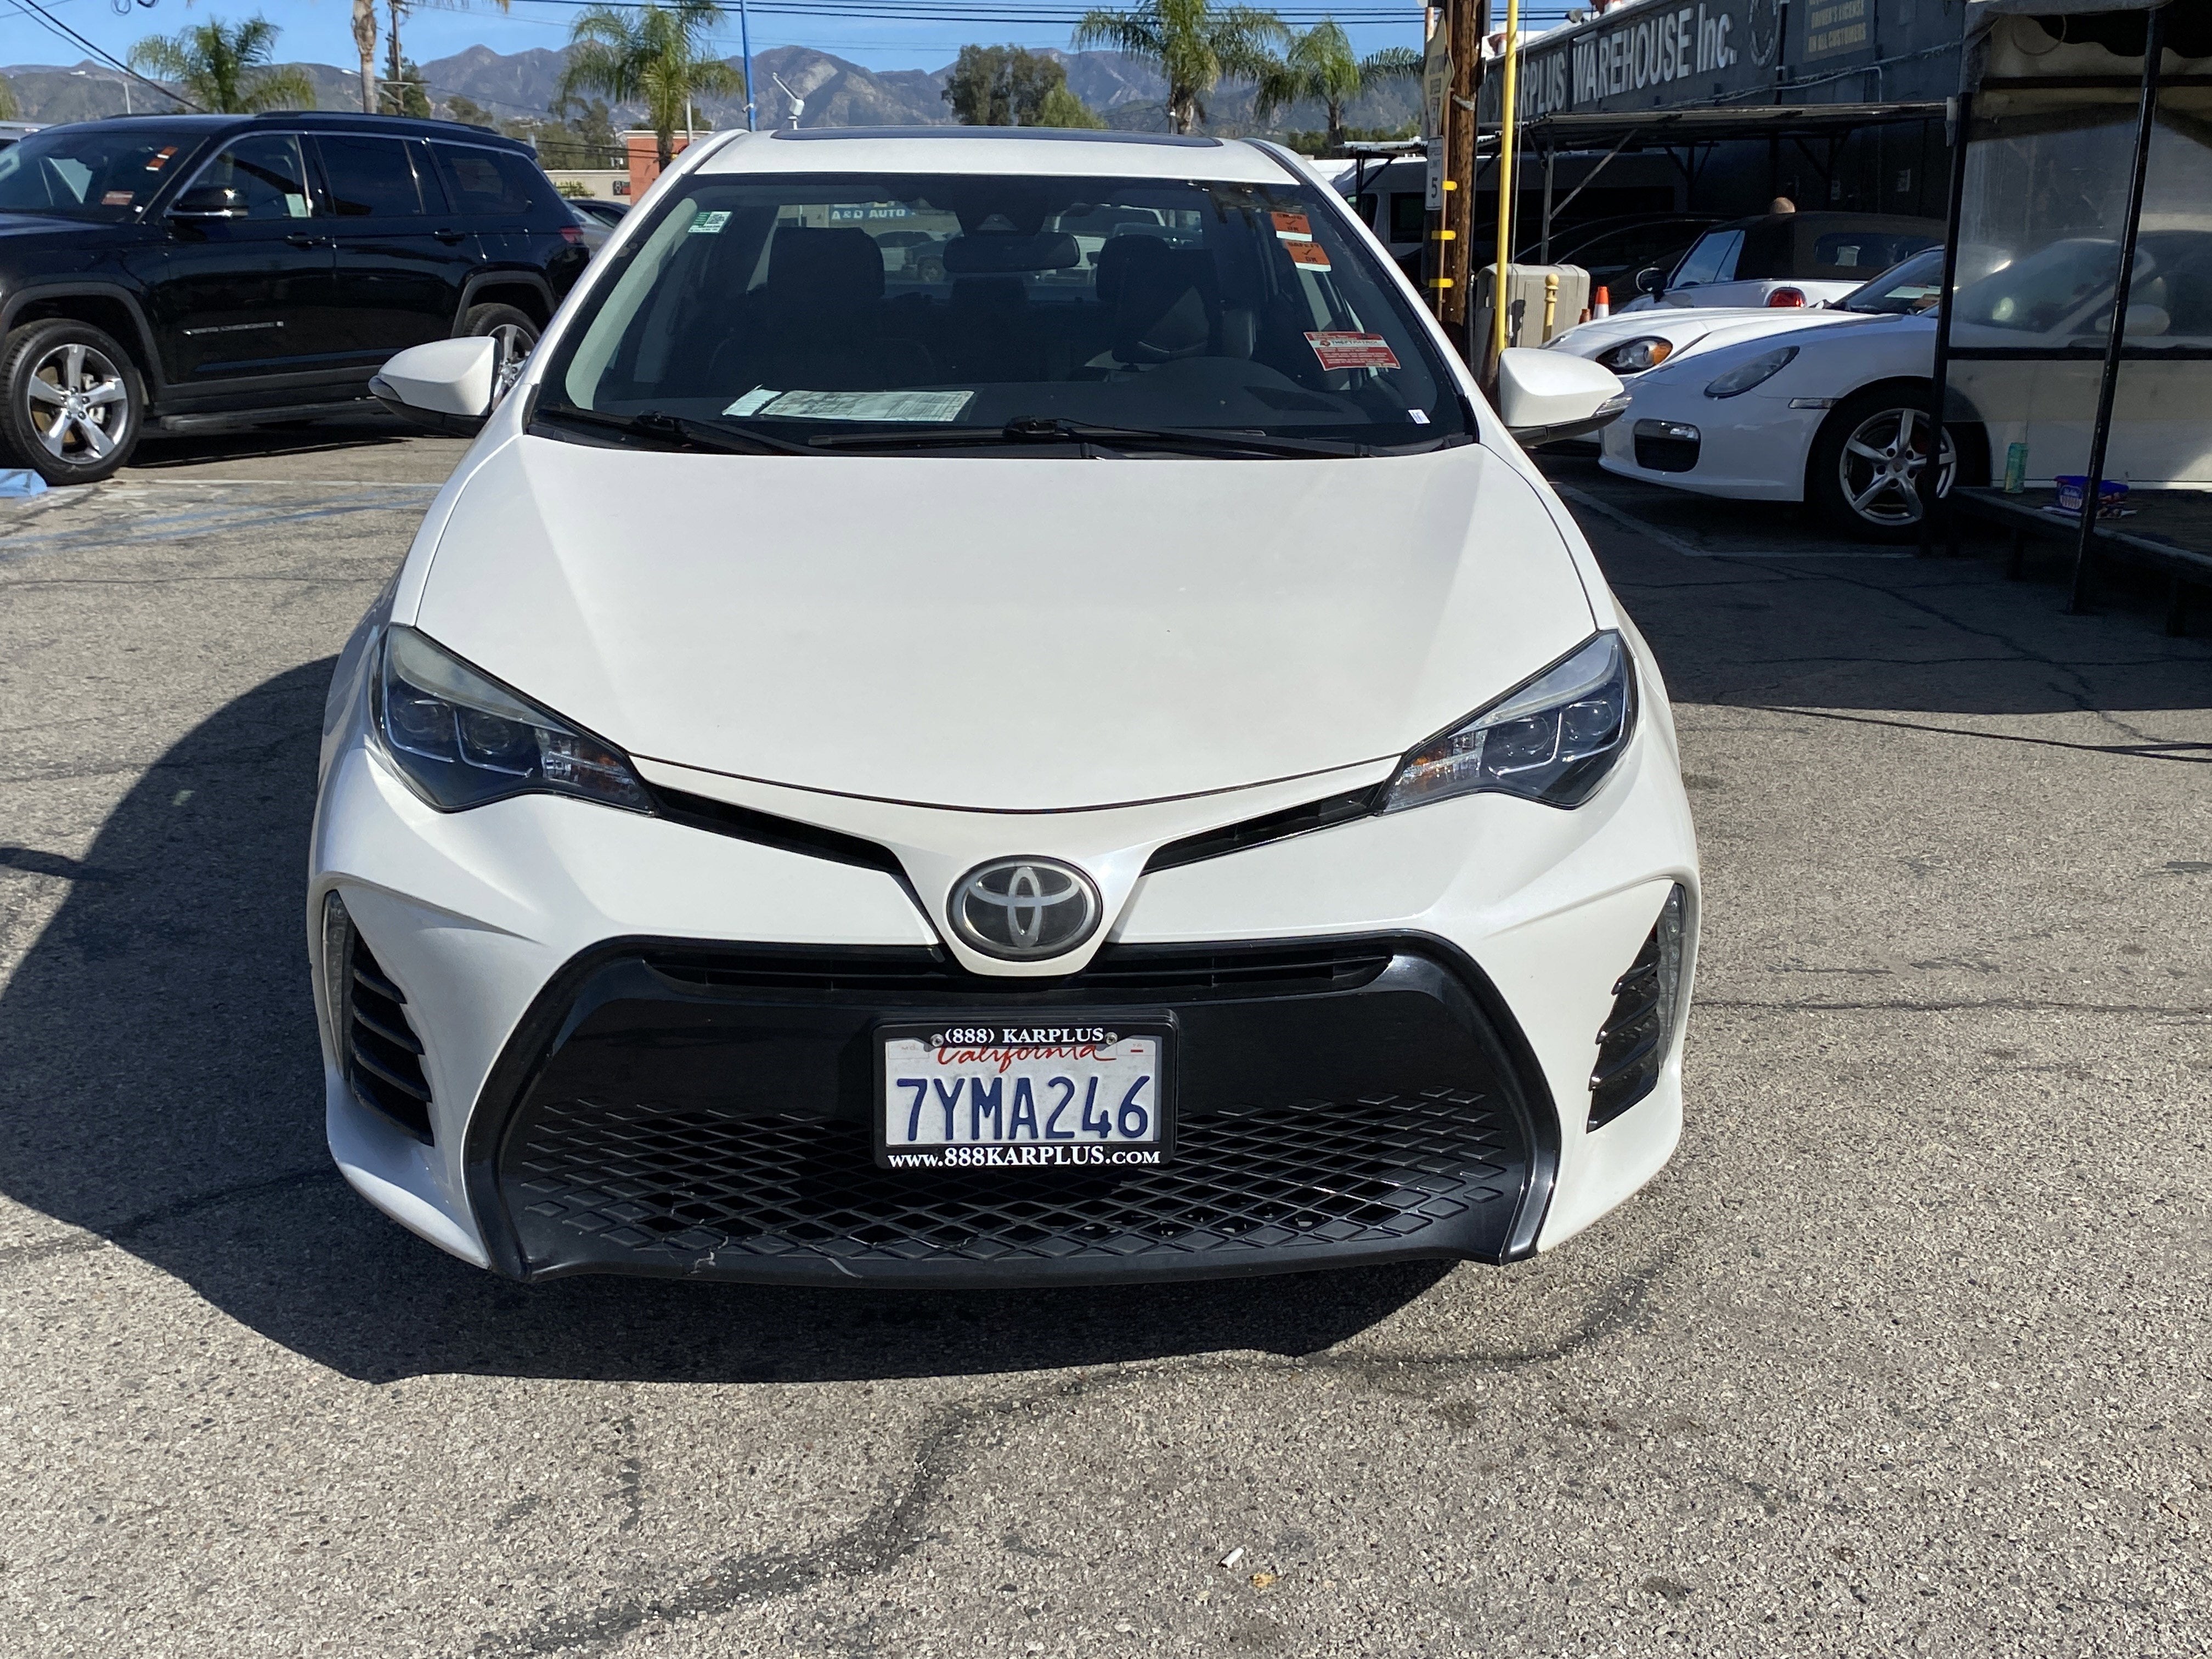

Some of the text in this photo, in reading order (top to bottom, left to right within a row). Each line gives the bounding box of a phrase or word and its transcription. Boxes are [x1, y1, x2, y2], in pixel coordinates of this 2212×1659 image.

[1573, 8, 1694, 104] WAREHOUSE
[1697, 4, 1737, 74] Inc.
[1431, 177, 1438, 199] 5
[868, 208, 905, 218] AUTO
[945, 1028, 1104, 1043] (888) KARPLUS
[938, 1044, 1118, 1074] California
[897, 1075, 1150, 1142] 7YMA246
